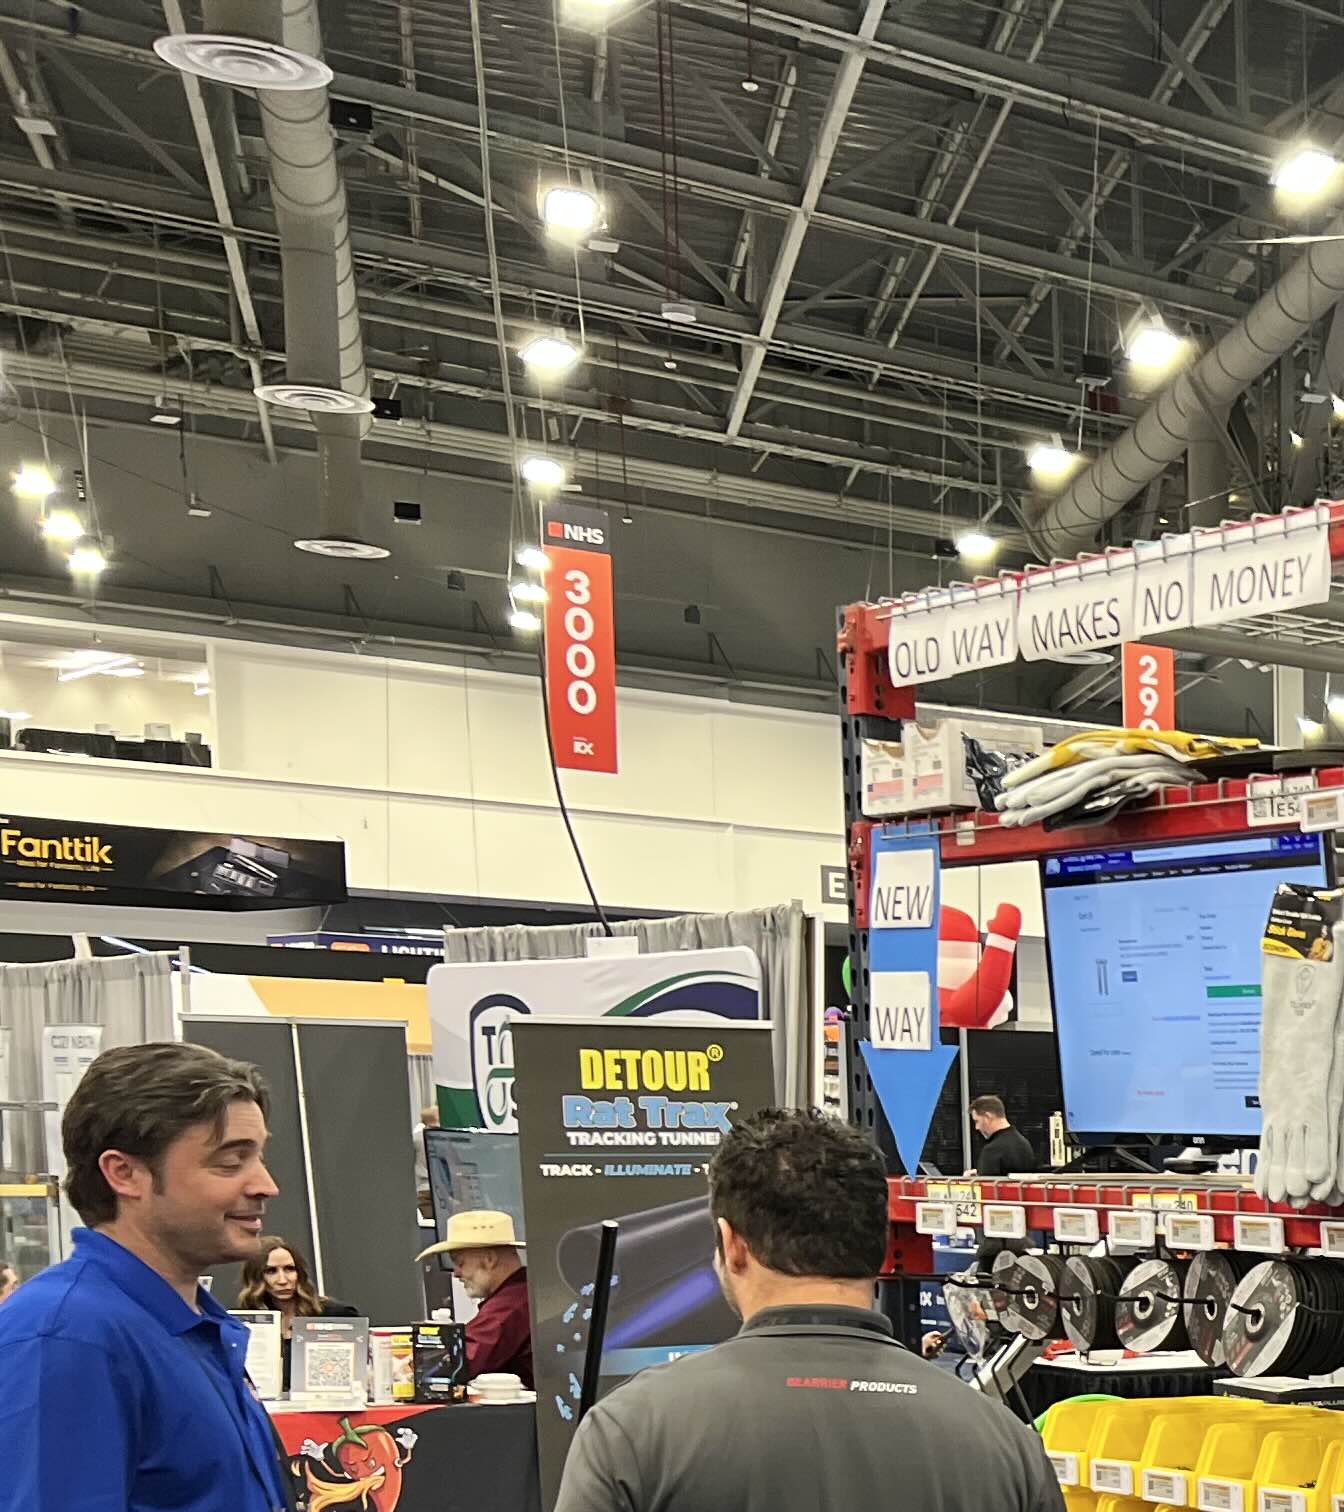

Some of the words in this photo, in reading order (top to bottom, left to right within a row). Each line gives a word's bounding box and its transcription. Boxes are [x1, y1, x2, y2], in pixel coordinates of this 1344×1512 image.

[563, 523, 605, 545] NHS
[895, 635, 940, 679] OLD
[952, 617, 1010, 667] WAY
[1031, 596, 1122, 654] MAKES
[1143, 580, 1185, 627] NO
[1209, 552, 1312, 612] MONEY
[564, 569, 597, 715] 3000
[1138, 654, 1160, 730] 29
[1, 828, 113, 865] Fanttik
[874, 885, 931, 921] NEW
[874, 1005, 930, 1042] WAY
[562, 1094, 638, 1129] Rat
[638, 1095, 734, 1136] Trax
[566, 1131, 657, 1147] TRACKING
[658, 1131, 721, 1147] TUNNE
[539, 1163, 594, 1178] TRACK
[604, 1163, 693, 1177] ILLUMINATE
[850, 1379, 918, 1395] PRODUCTS
